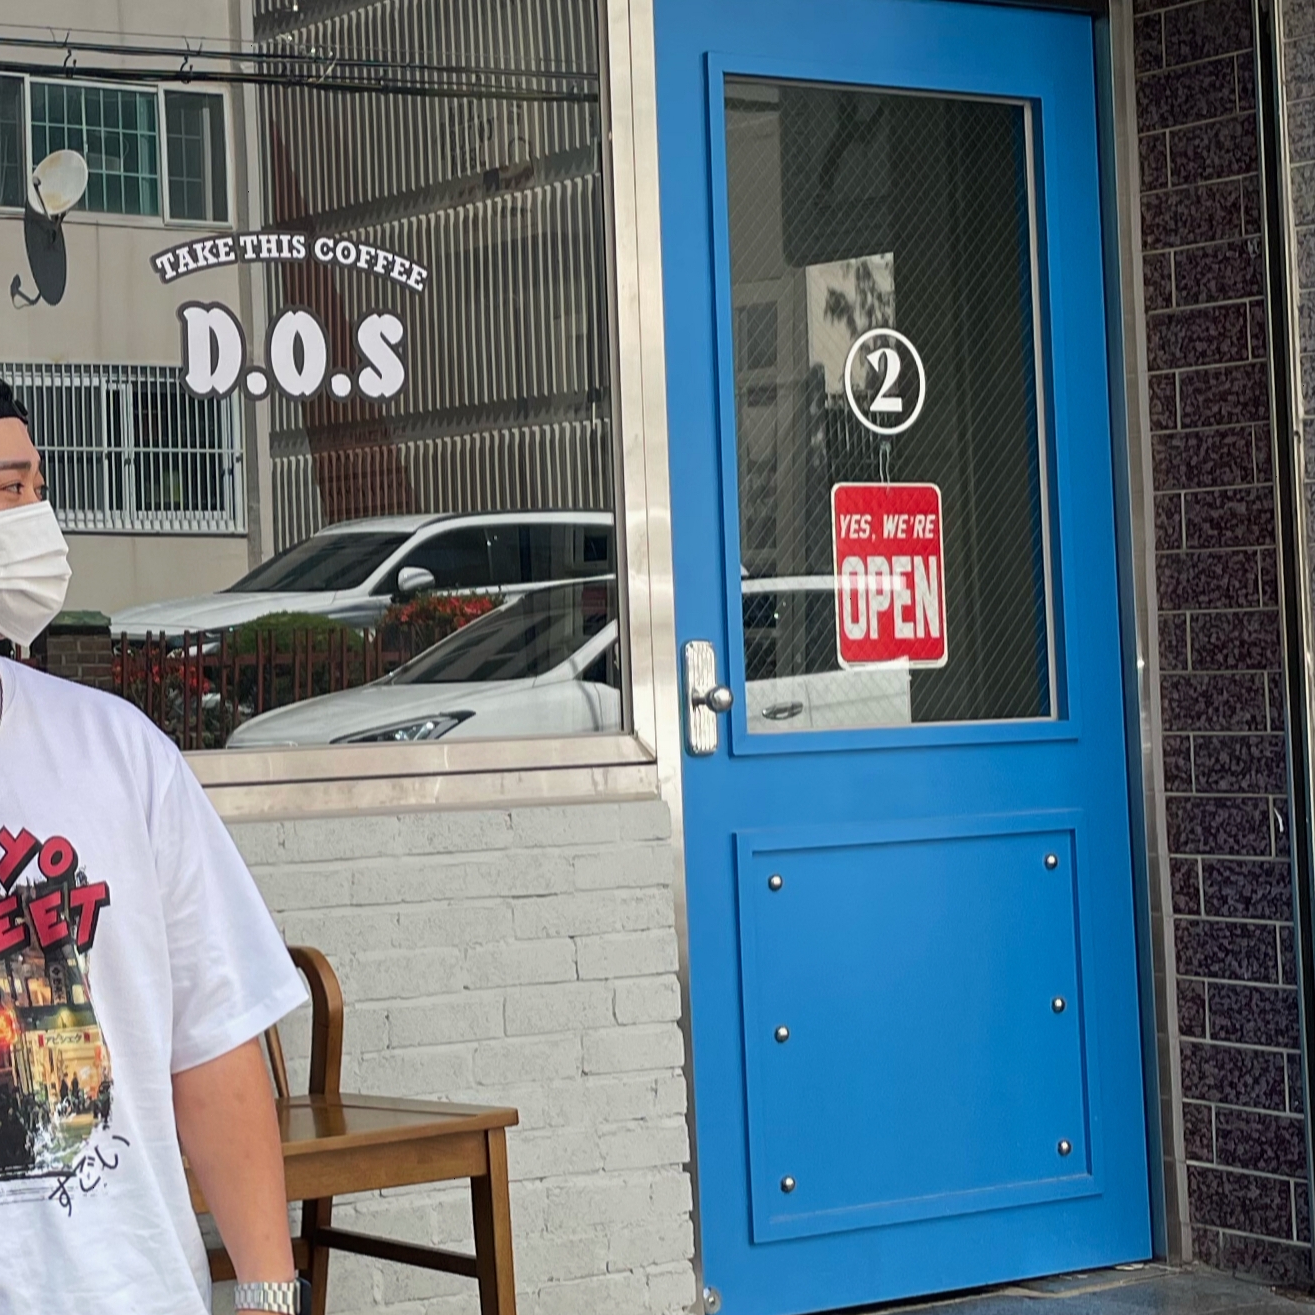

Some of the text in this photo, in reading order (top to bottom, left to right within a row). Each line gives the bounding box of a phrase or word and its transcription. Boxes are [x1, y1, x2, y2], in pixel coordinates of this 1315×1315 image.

[155, 234, 428, 292] TAKE THIS COFFEE
[183, 306, 405, 397] D.O.S
[866, 347, 903, 412] 2
[840, 514, 936, 543] YES, WE'RE
[841, 555, 940, 639] OPEN
